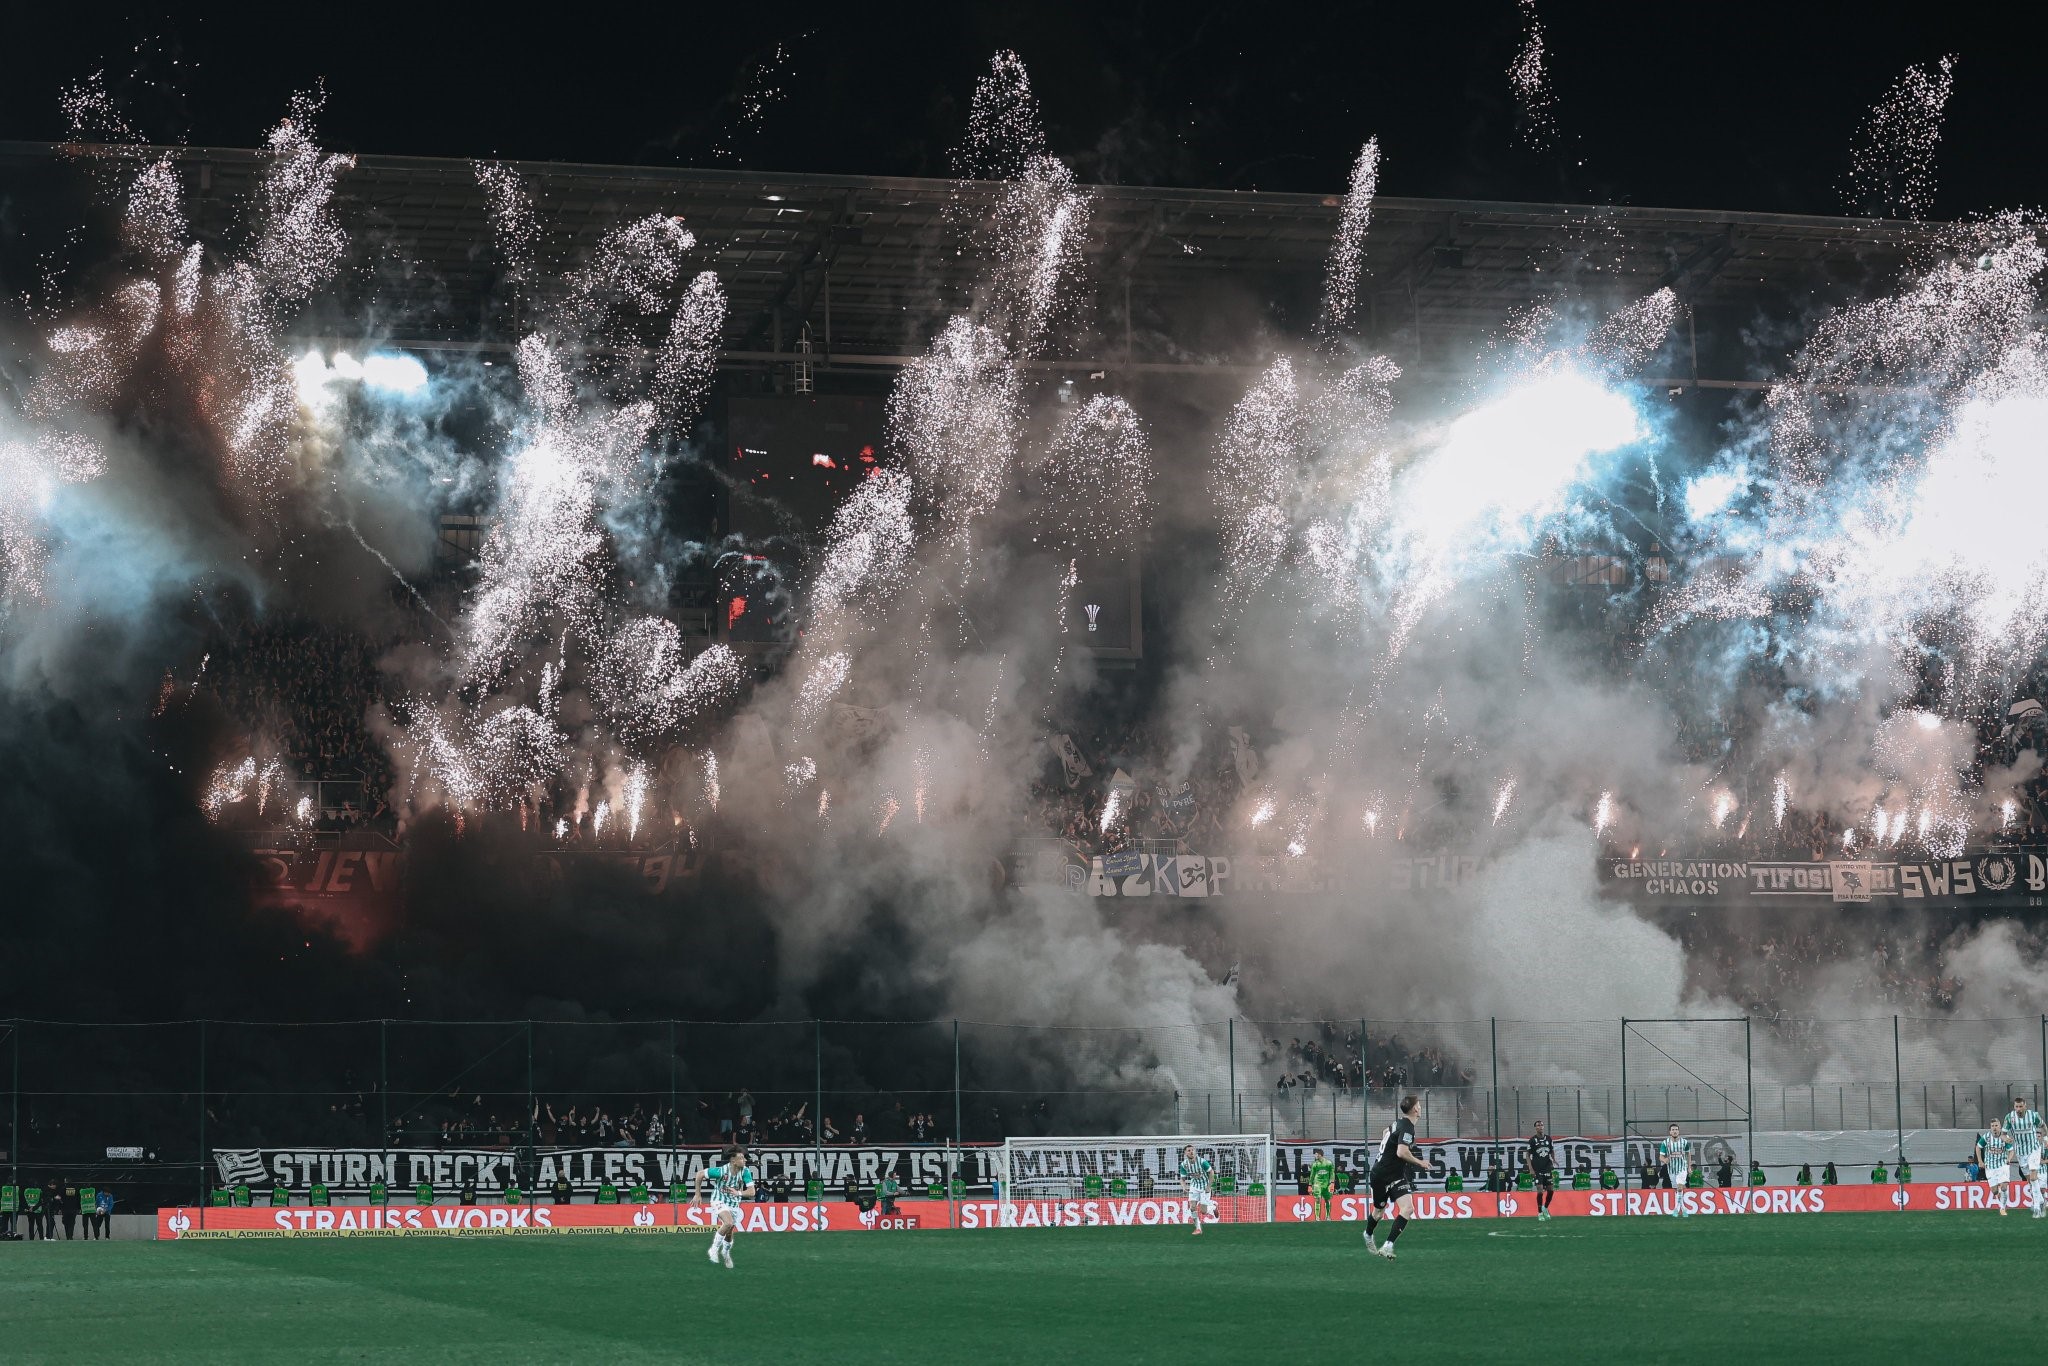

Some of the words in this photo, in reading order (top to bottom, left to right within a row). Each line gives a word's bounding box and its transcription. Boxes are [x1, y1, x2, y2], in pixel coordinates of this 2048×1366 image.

[1614, 861, 1747, 879] GENERATION
[1900, 861, 1977, 898] SWS
[1646, 878, 1719, 895] CHAOS
[273, 1153, 397, 1188] STURM
[408, 1154, 517, 1188] DECKT
[910, 1152, 964, 1184] IST
[1009, 1149, 1145, 1178] MEINEM
[1157, 1147, 1263, 1181] LBEN
[1275, 1148, 1371, 1181] ALES
[1563, 1144, 1612, 1176] IST
[1935, 1184, 2042, 1210] STRAUS
[1589, 1188, 1825, 1216] STRAUSS.WORKS
[1341, 1195, 1473, 1220] STRUSS
[880, 1218, 917, 1230] ORF
[182, 1230, 234, 1239] ADMIRAL
[237, 1230, 290, 1239] ADMIRAL
[293, 1230, 345, 1238] ADMIRAL
[349, 1229, 400, 1238] ADMIRAL
[403, 1229, 455, 1237] ADMIRAL
[458, 1229, 509, 1237] ADMIRAL
[513, 1228, 563, 1236] ADMIRAL
[567, 1227, 618, 1235] ADMIRAL
[622, 1227, 673, 1235] ADMIRAL
[676, 1226, 721, 1234] ADMIRA
